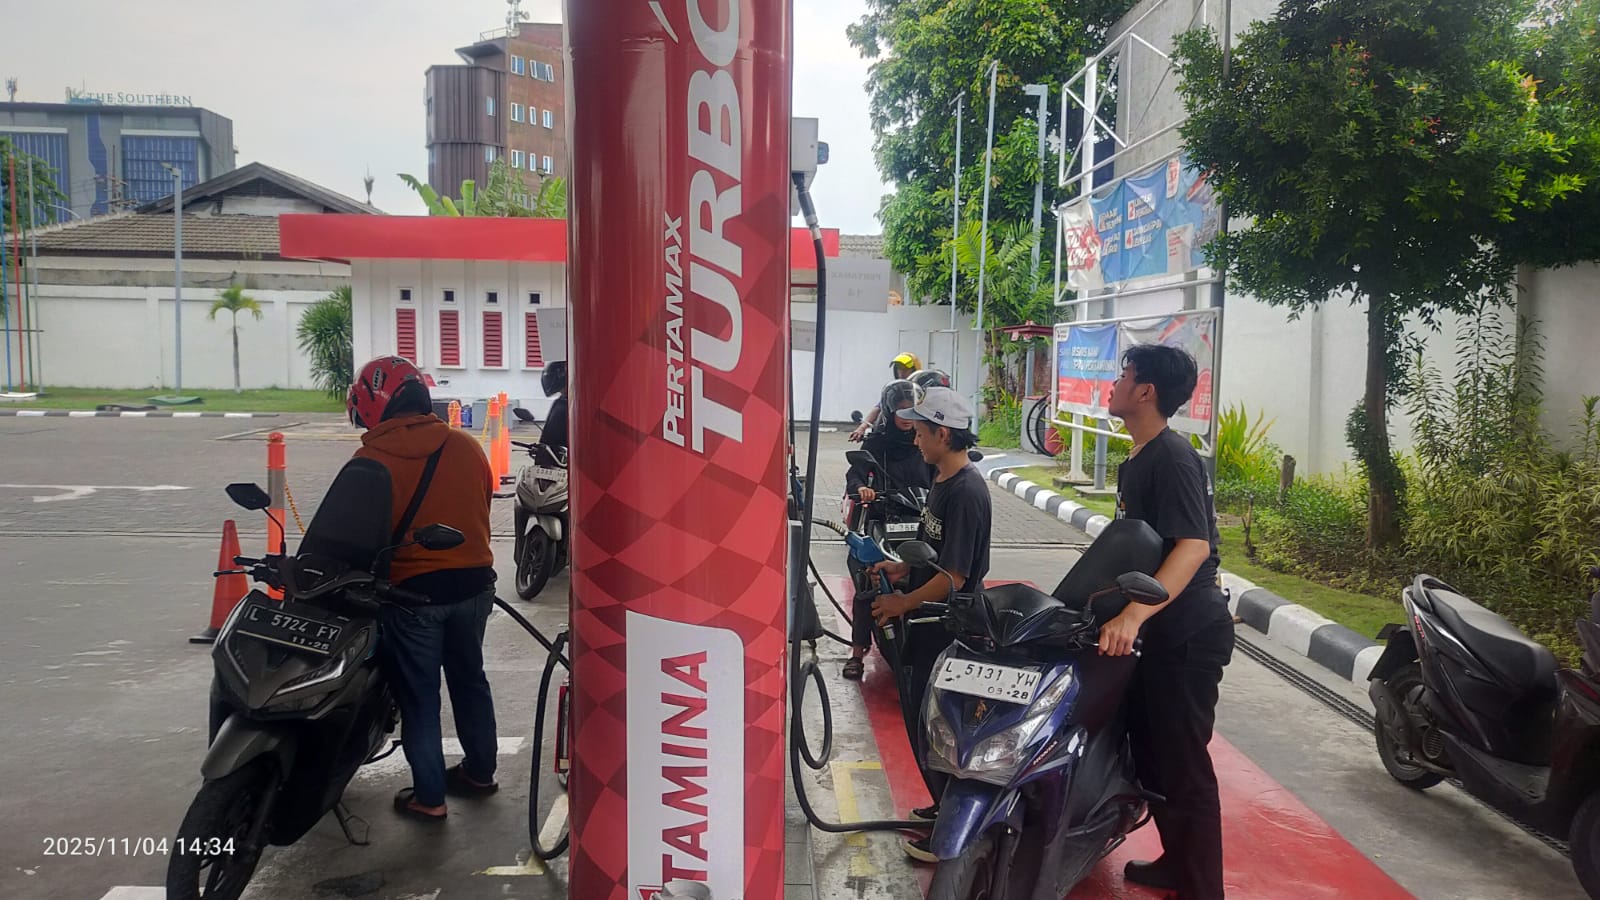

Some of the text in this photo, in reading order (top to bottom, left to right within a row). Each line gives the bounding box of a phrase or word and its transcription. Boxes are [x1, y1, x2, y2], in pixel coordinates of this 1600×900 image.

[86, 91, 192, 106] THE SOUTHERN
[663, 211, 685, 447] PERTAMAX
[250, 608, 338, 640] L 5724 FY
[945, 661, 1037, 687] L 5131 YW
